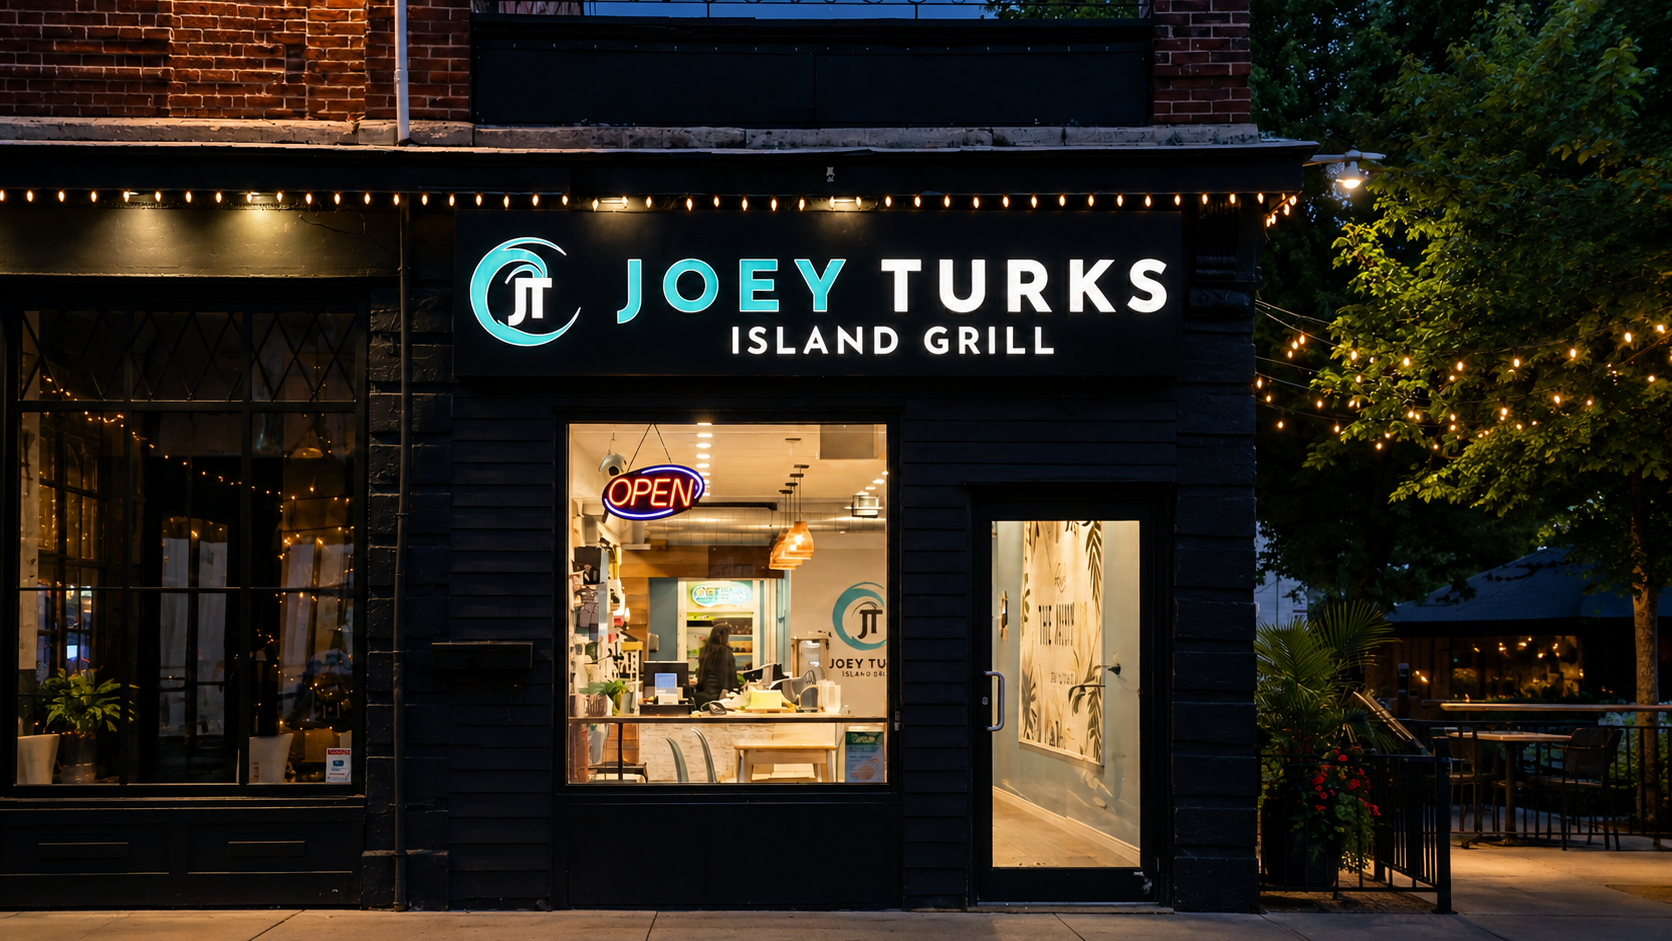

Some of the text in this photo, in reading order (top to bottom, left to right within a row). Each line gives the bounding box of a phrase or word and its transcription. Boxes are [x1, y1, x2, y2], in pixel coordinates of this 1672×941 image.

[507, 277, 553, 327] JT
[617, 258, 1168, 325] JOEY TURKS
[731, 326, 1055, 355] ISLAND GRILL
[608, 478, 694, 507] OPEN
[857, 609, 883, 640] JT
[829, 658, 864, 669] JOEY
